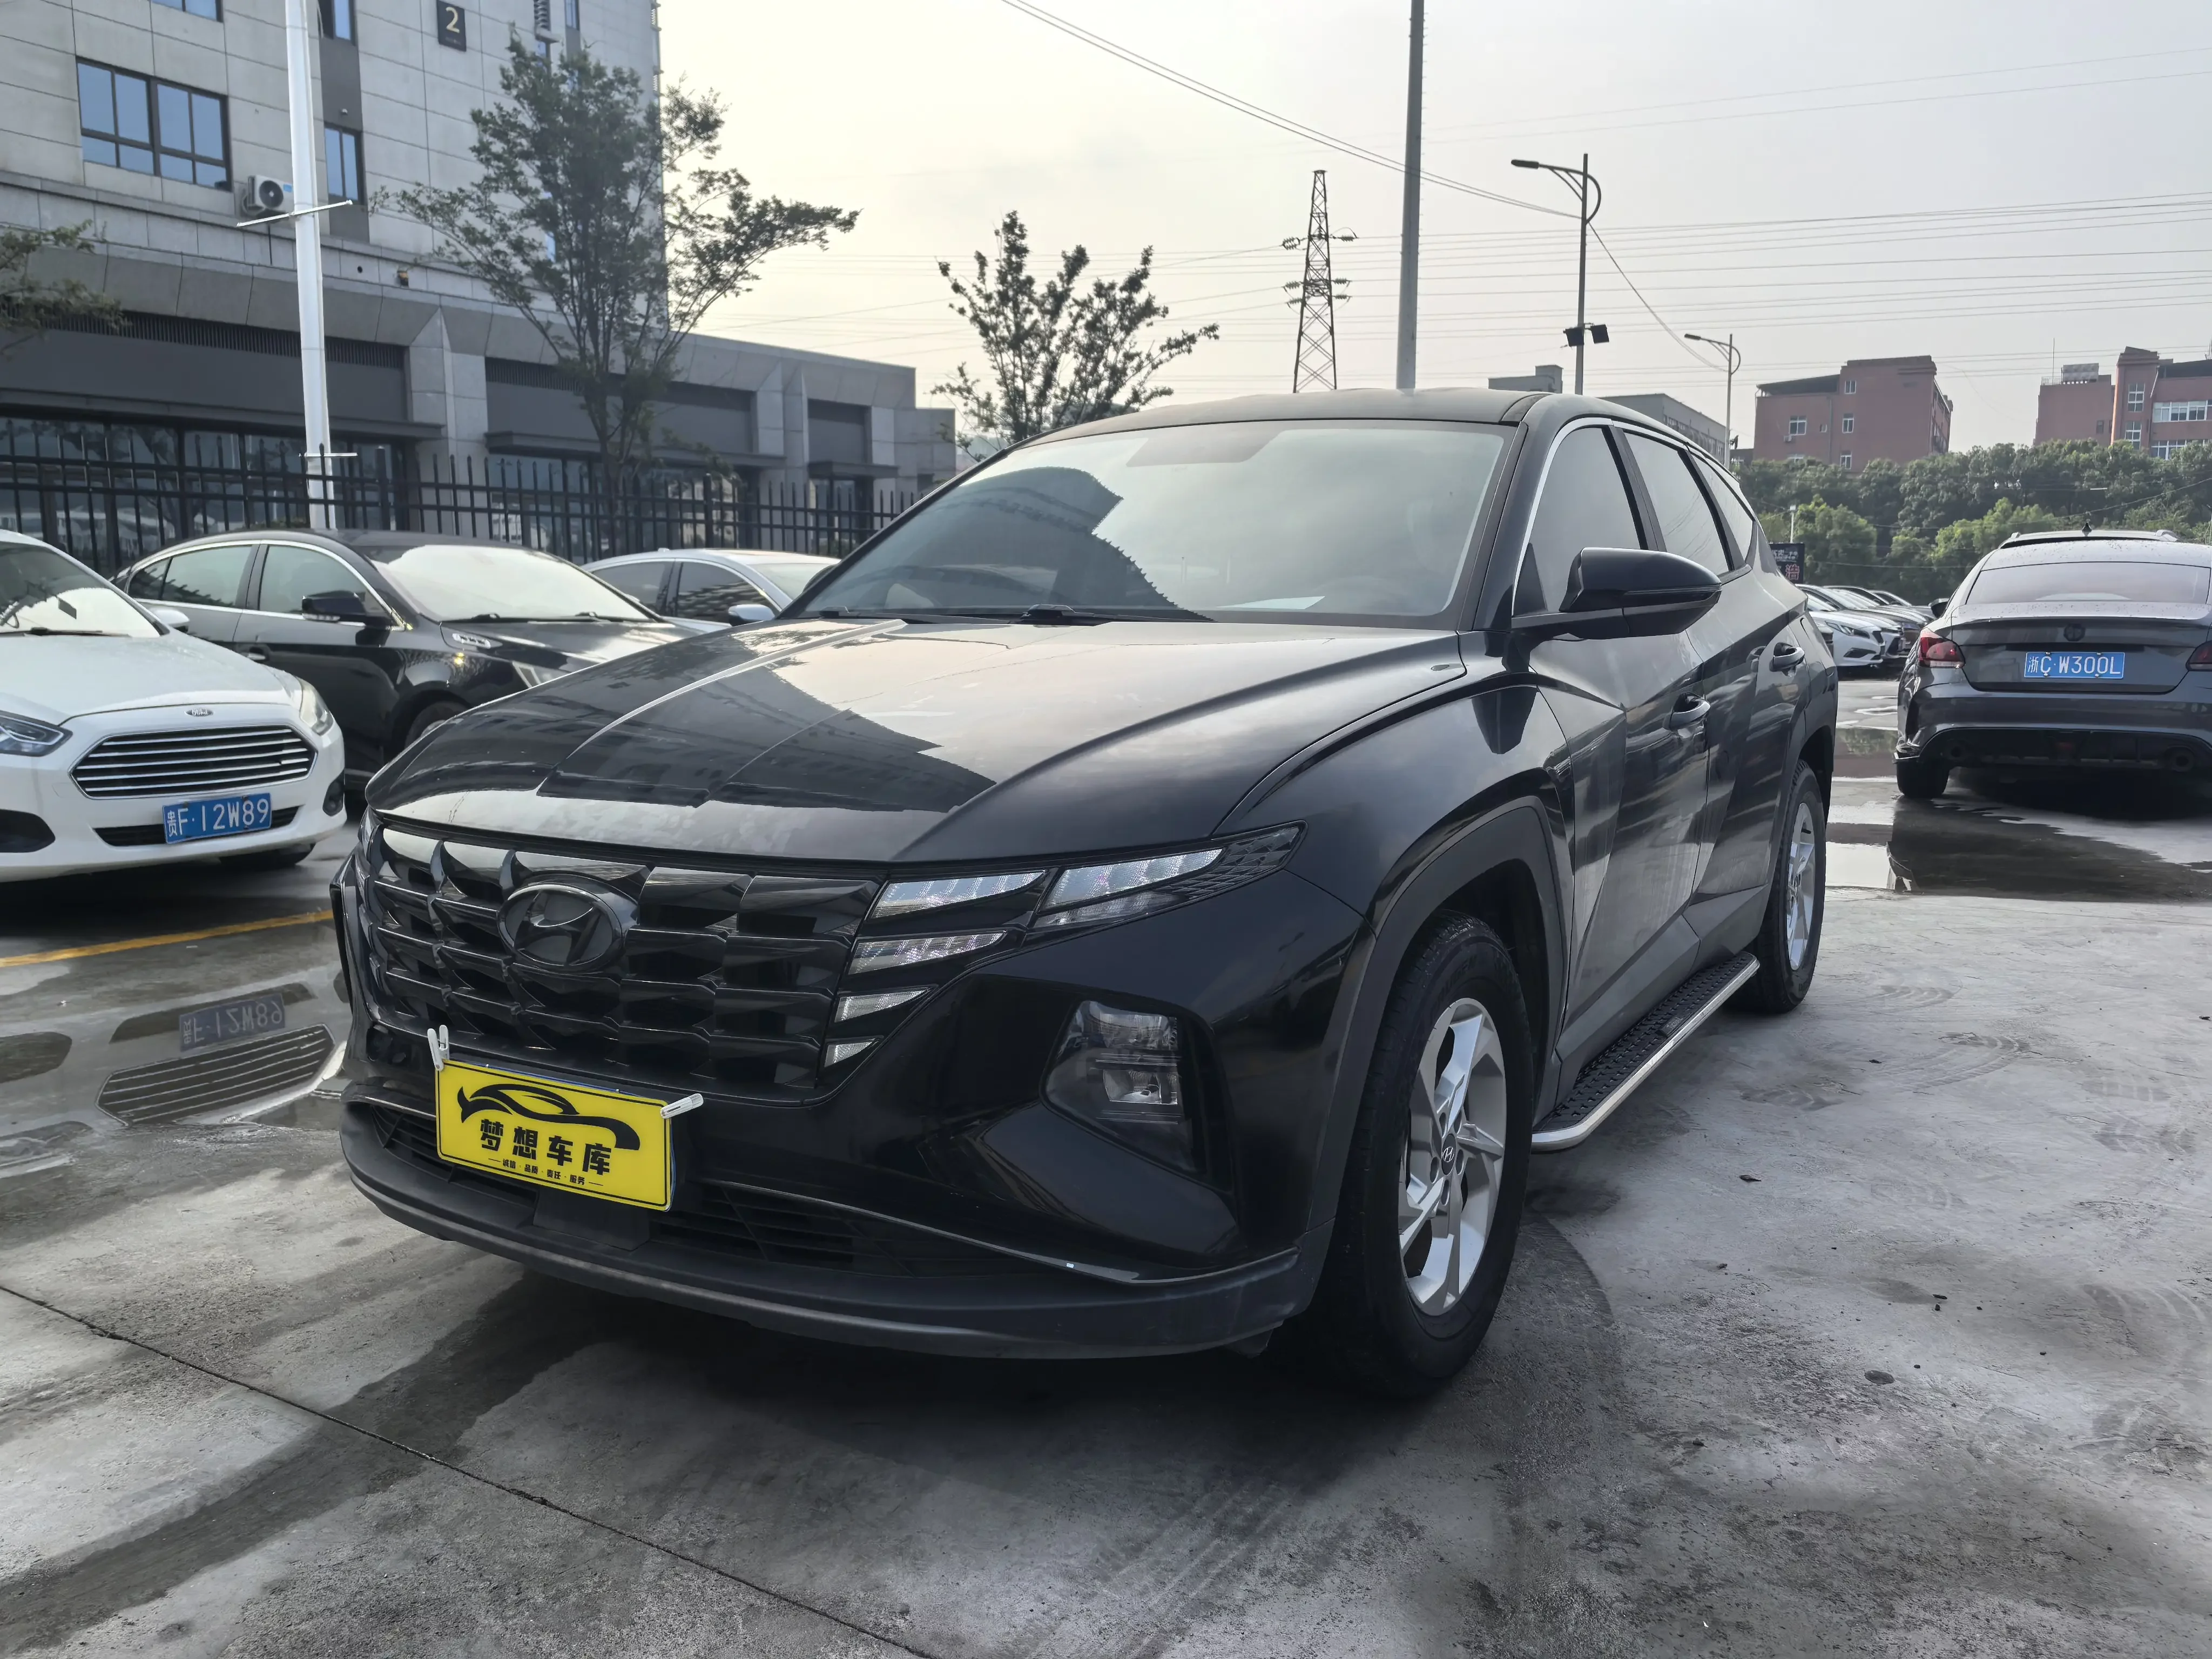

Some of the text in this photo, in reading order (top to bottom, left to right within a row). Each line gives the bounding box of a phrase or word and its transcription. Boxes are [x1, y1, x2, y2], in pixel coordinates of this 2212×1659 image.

[445, 6, 460, 33] 2
[480, 1118, 612, 1176] 梦想车库
[524, 1163, 538, 1175] 品质
[547, 1169, 561, 1179] 责任
